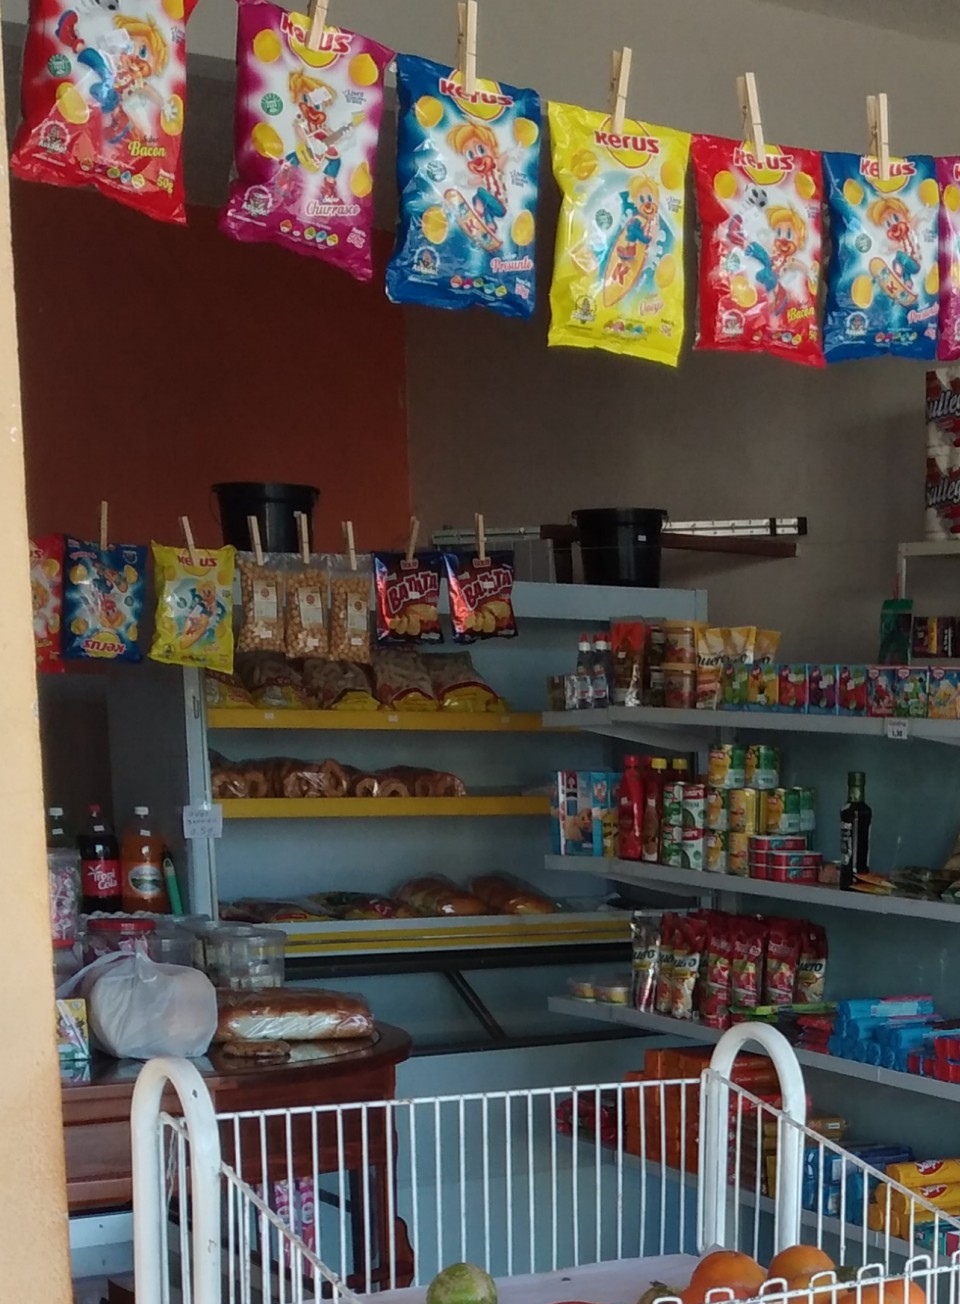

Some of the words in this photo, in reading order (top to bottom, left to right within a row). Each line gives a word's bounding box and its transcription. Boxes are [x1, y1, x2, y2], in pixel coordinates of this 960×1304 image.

[280, 13, 352, 53] Keus
[128, 141, 166, 157] Bacon
[595, 131, 660, 154] Kerus
[733, 147, 794, 172] Keus
[859, 158, 917, 178] Keus
[305, 201, 361, 217] Churrasco
[612, 263, 630, 285] K
[176, 557, 217, 570] Keus
[82, 638, 128, 656] Kerus
[633, 949, 655, 960] uero
[798, 962, 823, 972] uero
